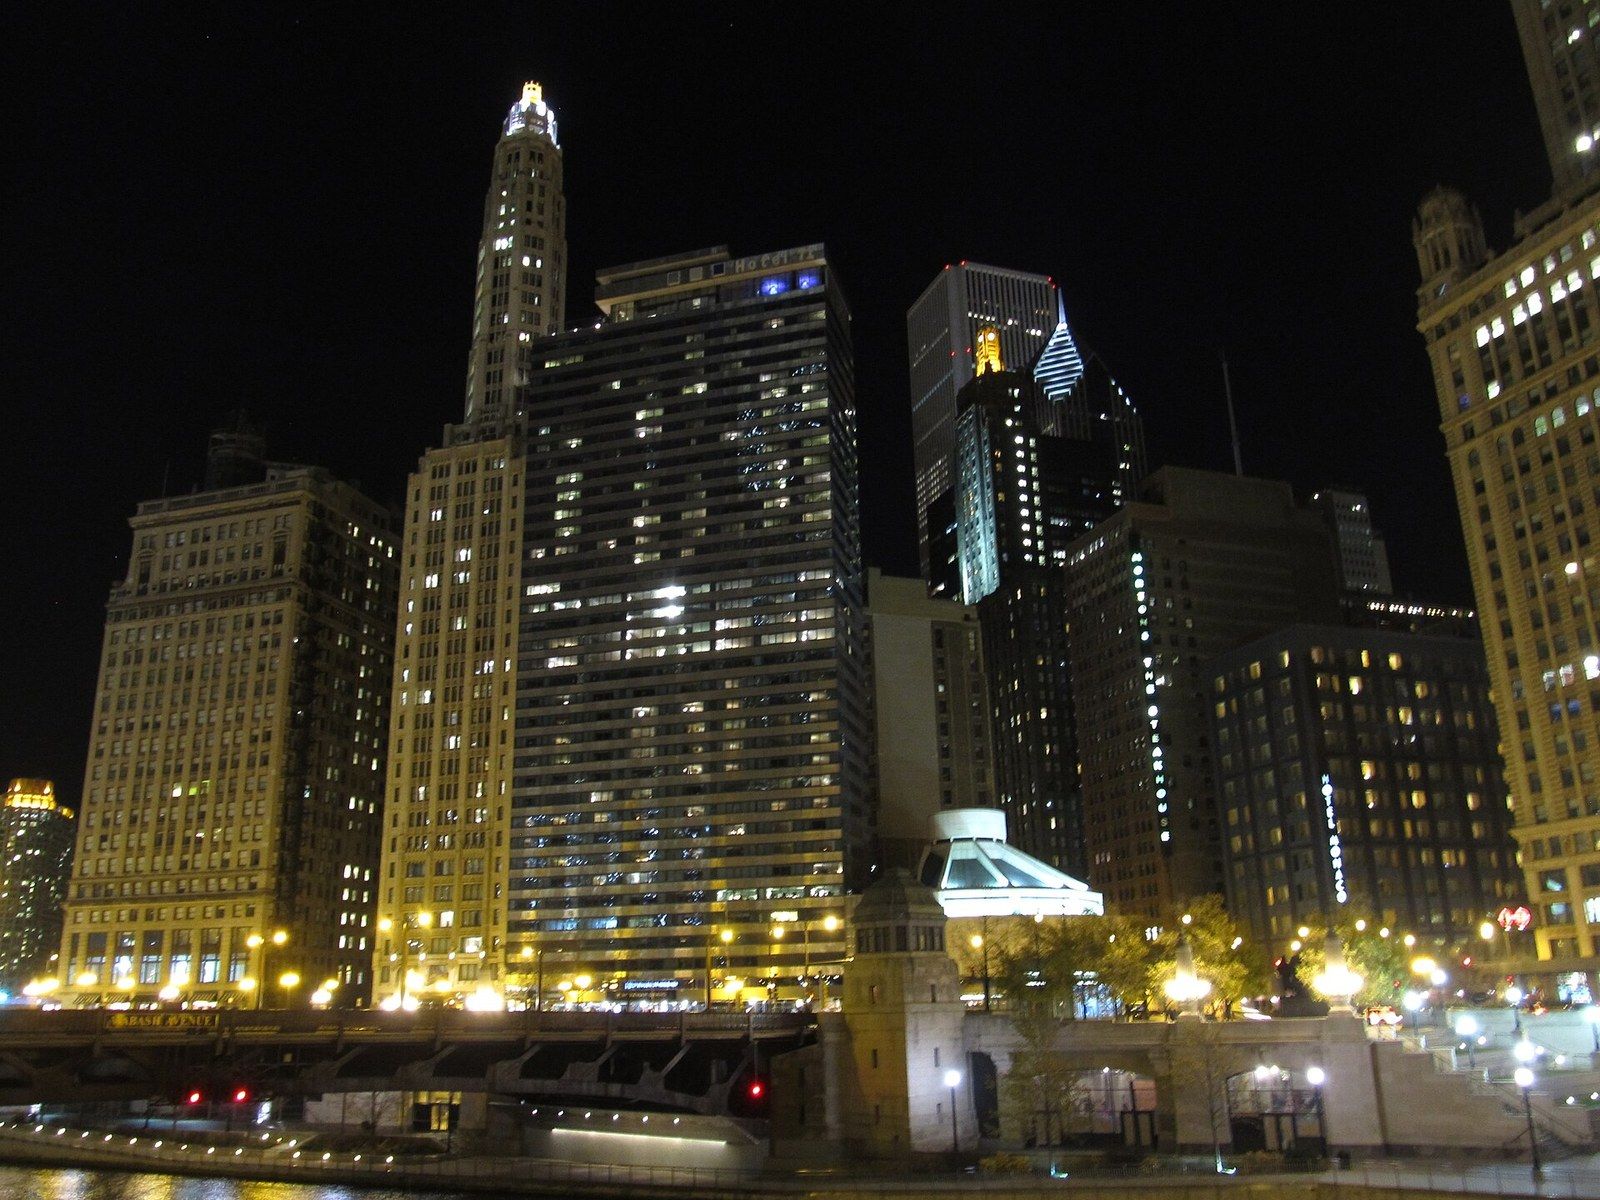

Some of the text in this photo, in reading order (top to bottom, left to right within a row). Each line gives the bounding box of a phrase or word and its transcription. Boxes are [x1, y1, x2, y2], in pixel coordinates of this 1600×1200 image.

[1143, 657, 1156, 695] THE
[1148, 705, 1171, 842] STEAKHOUSE
[1321, 774, 1347, 903] HOTEL MONACO
[167, 1013, 213, 1026] AVENUE
